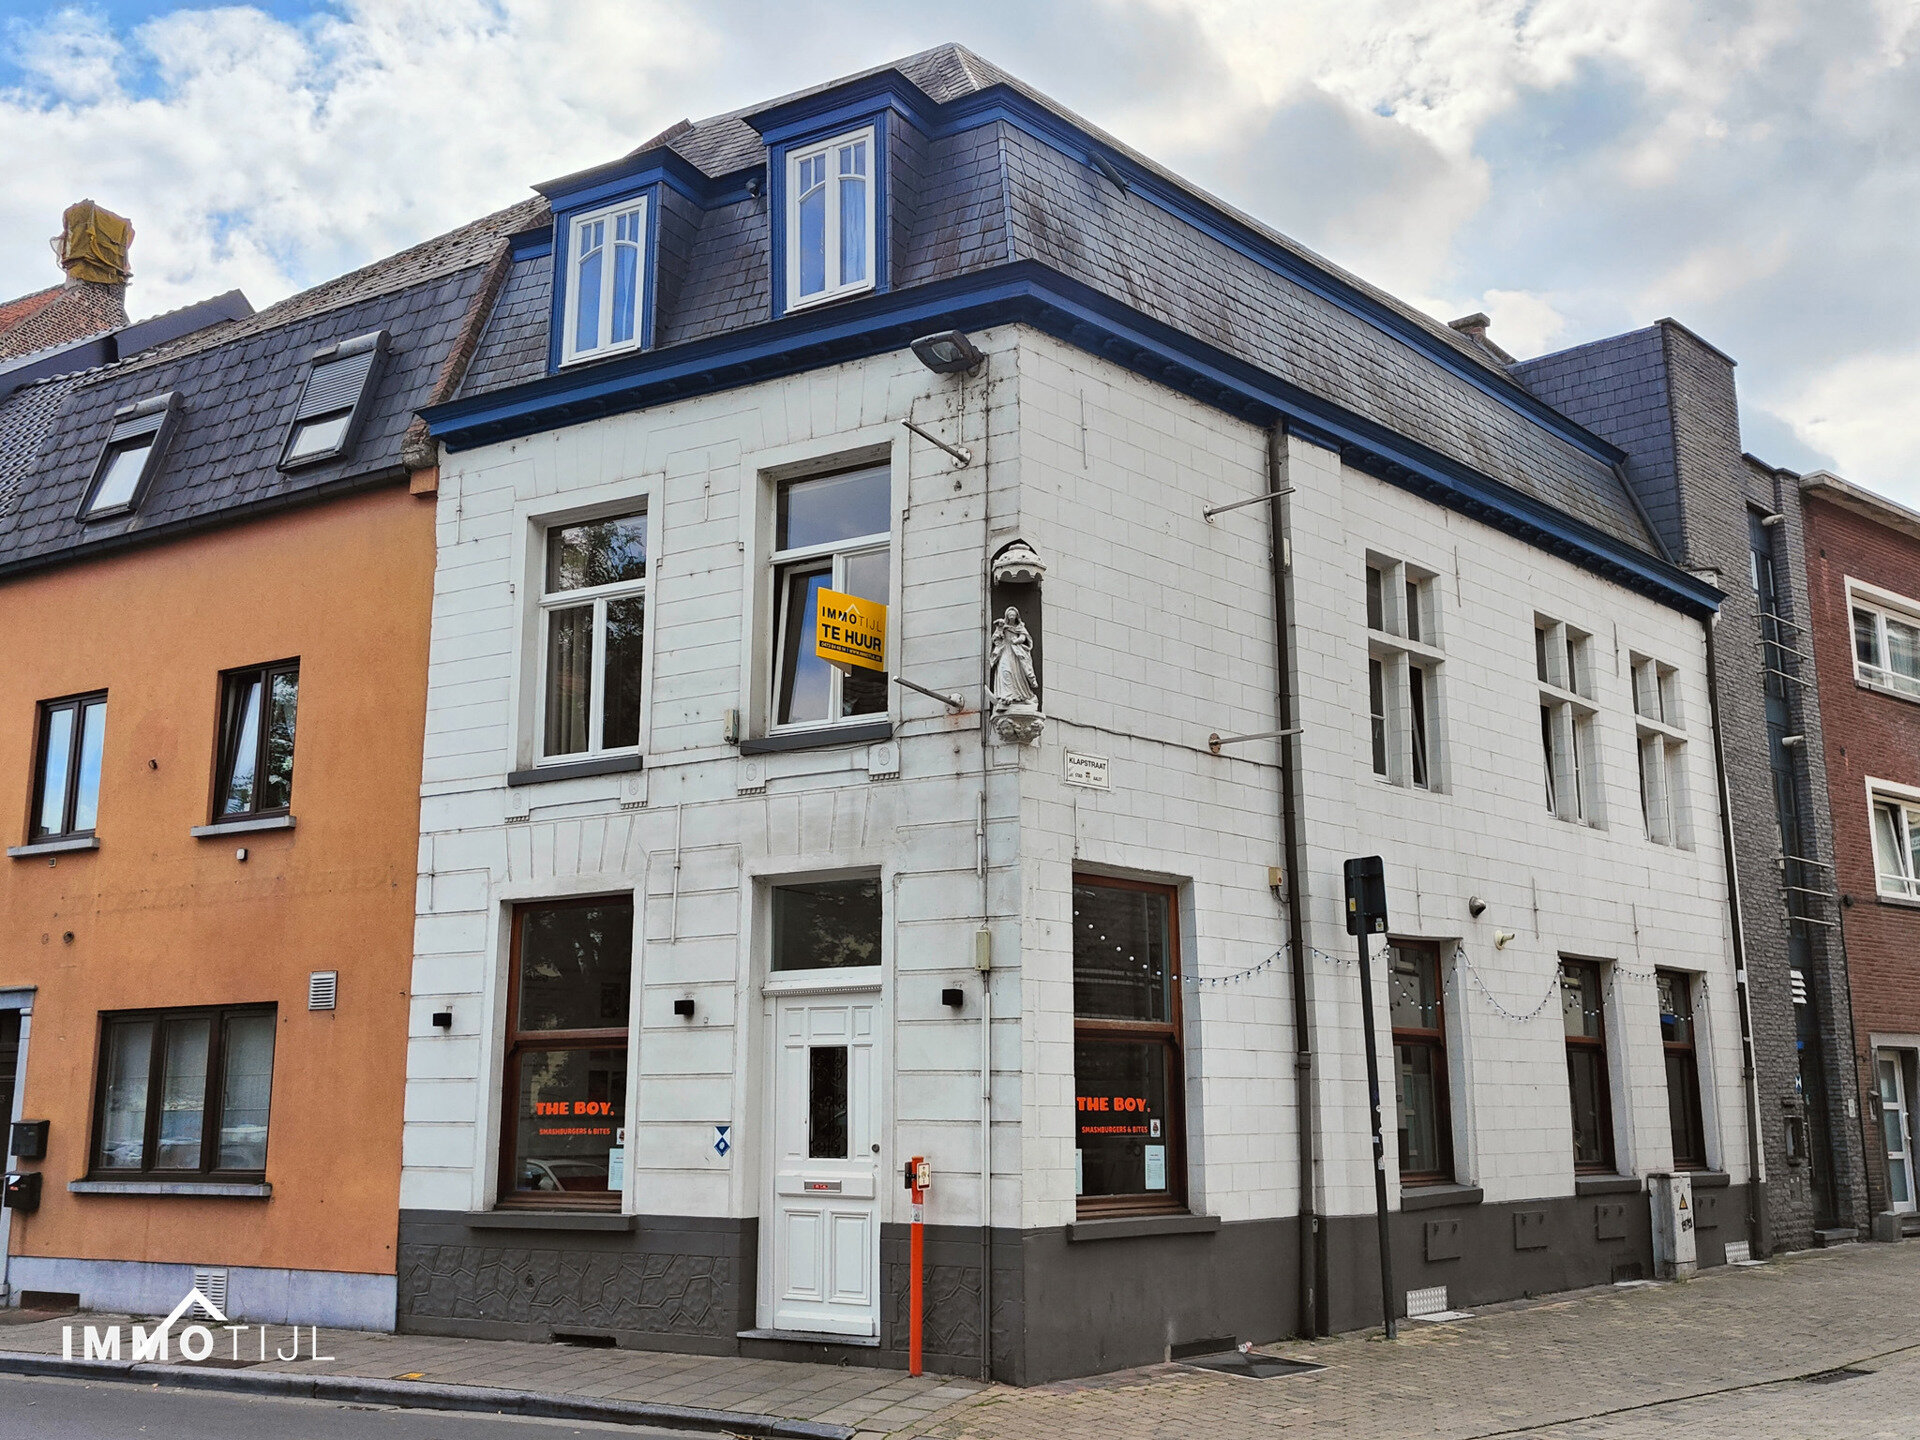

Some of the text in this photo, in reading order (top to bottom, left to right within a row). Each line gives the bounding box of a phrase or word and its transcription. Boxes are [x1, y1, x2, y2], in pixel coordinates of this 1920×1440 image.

[822, 623, 882, 652] TE HUUR
[1069, 757, 1106, 770] KLAPSTRAAT
[535, 1101, 615, 1116] THE BOY.
[1076, 1096, 1151, 1113] THE BOY.
[1132, 1125, 1148, 1133] BITES
